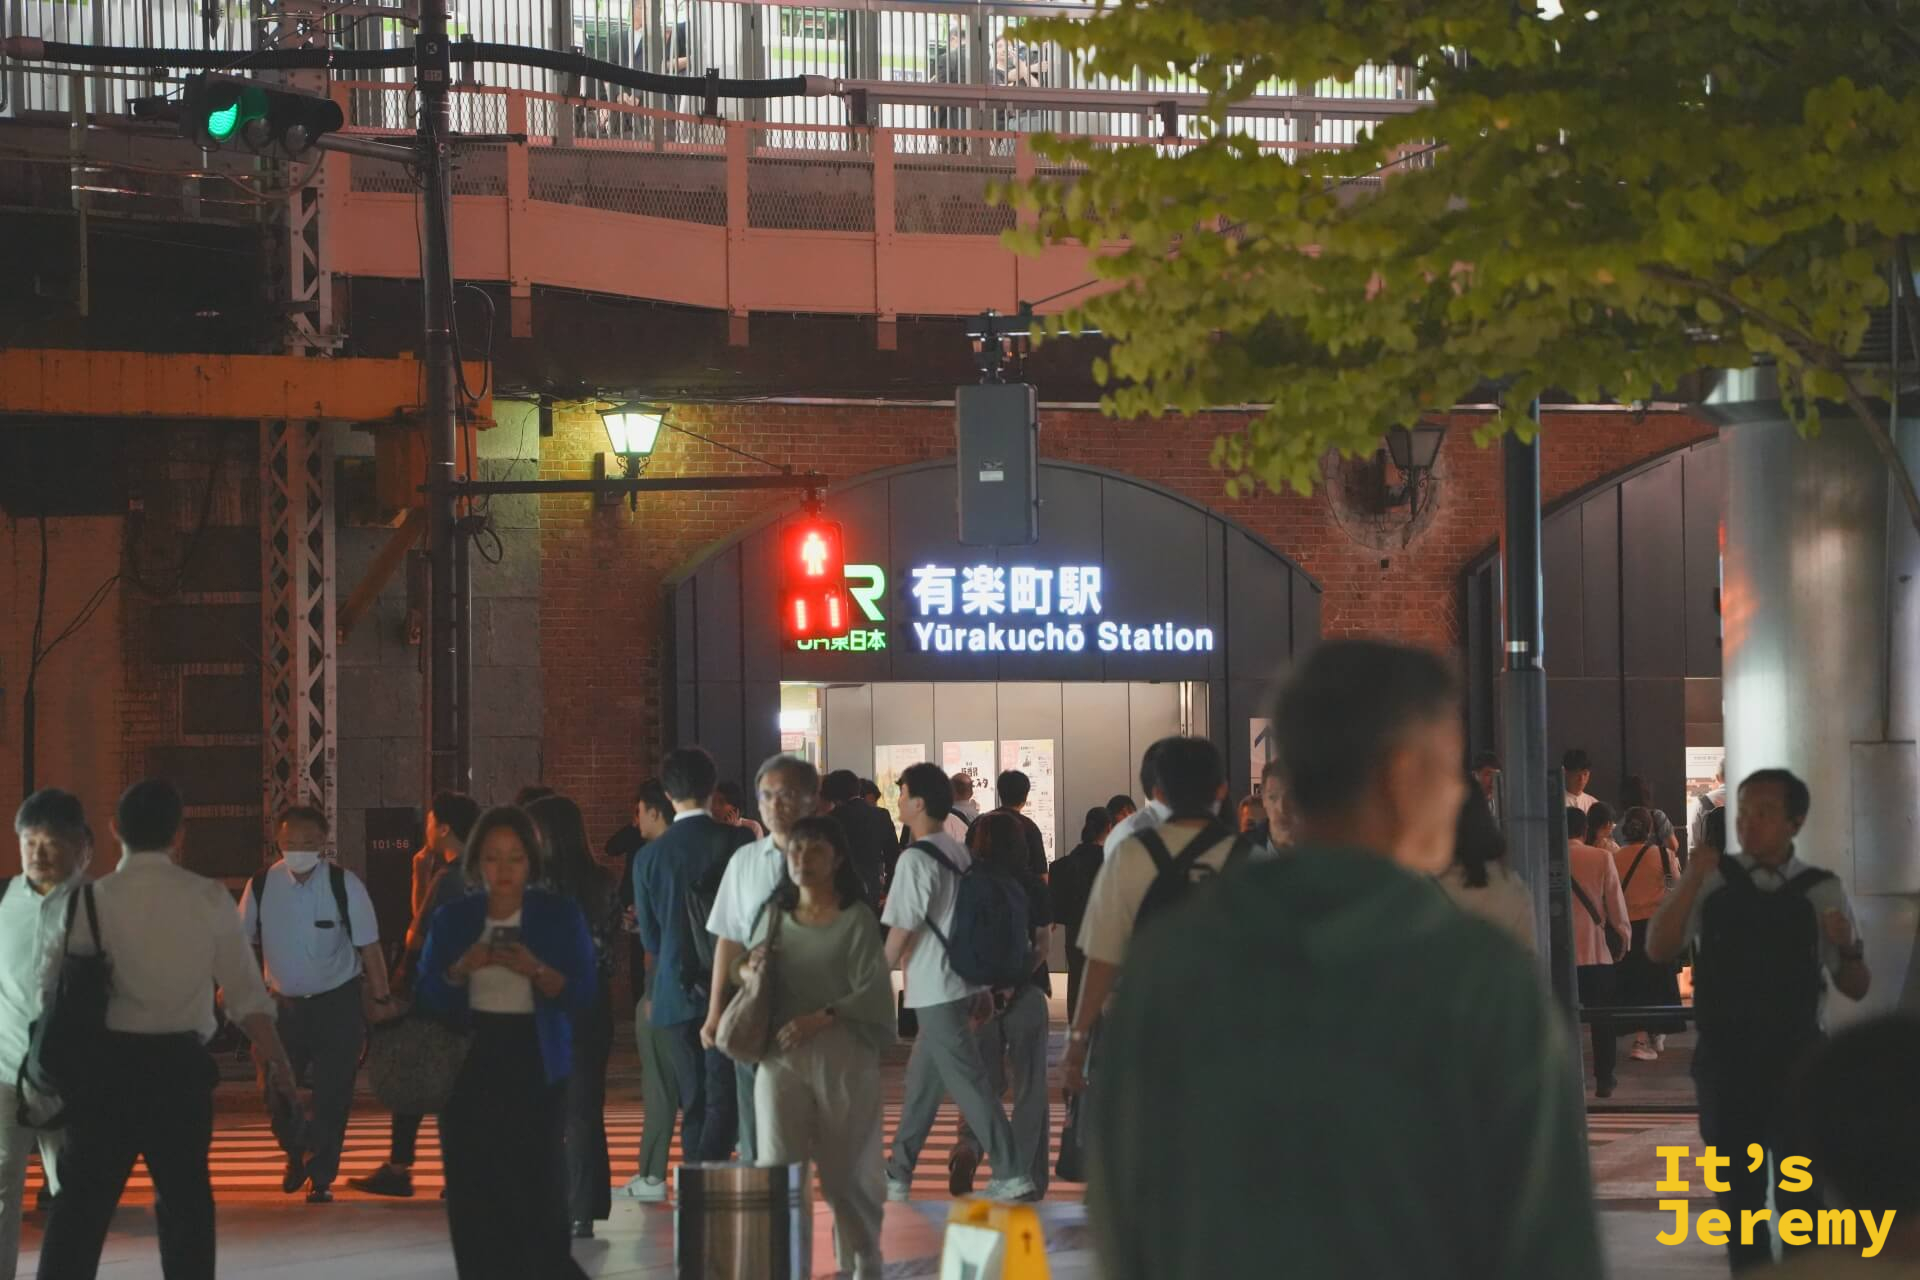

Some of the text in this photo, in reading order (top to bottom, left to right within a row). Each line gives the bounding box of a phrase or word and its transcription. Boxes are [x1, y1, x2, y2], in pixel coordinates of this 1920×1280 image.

[844, 565, 885, 621] R
[912, 565, 1101, 615] 有楽町駅
[913, 621, 1213, 651] Yūrakuchō Station
